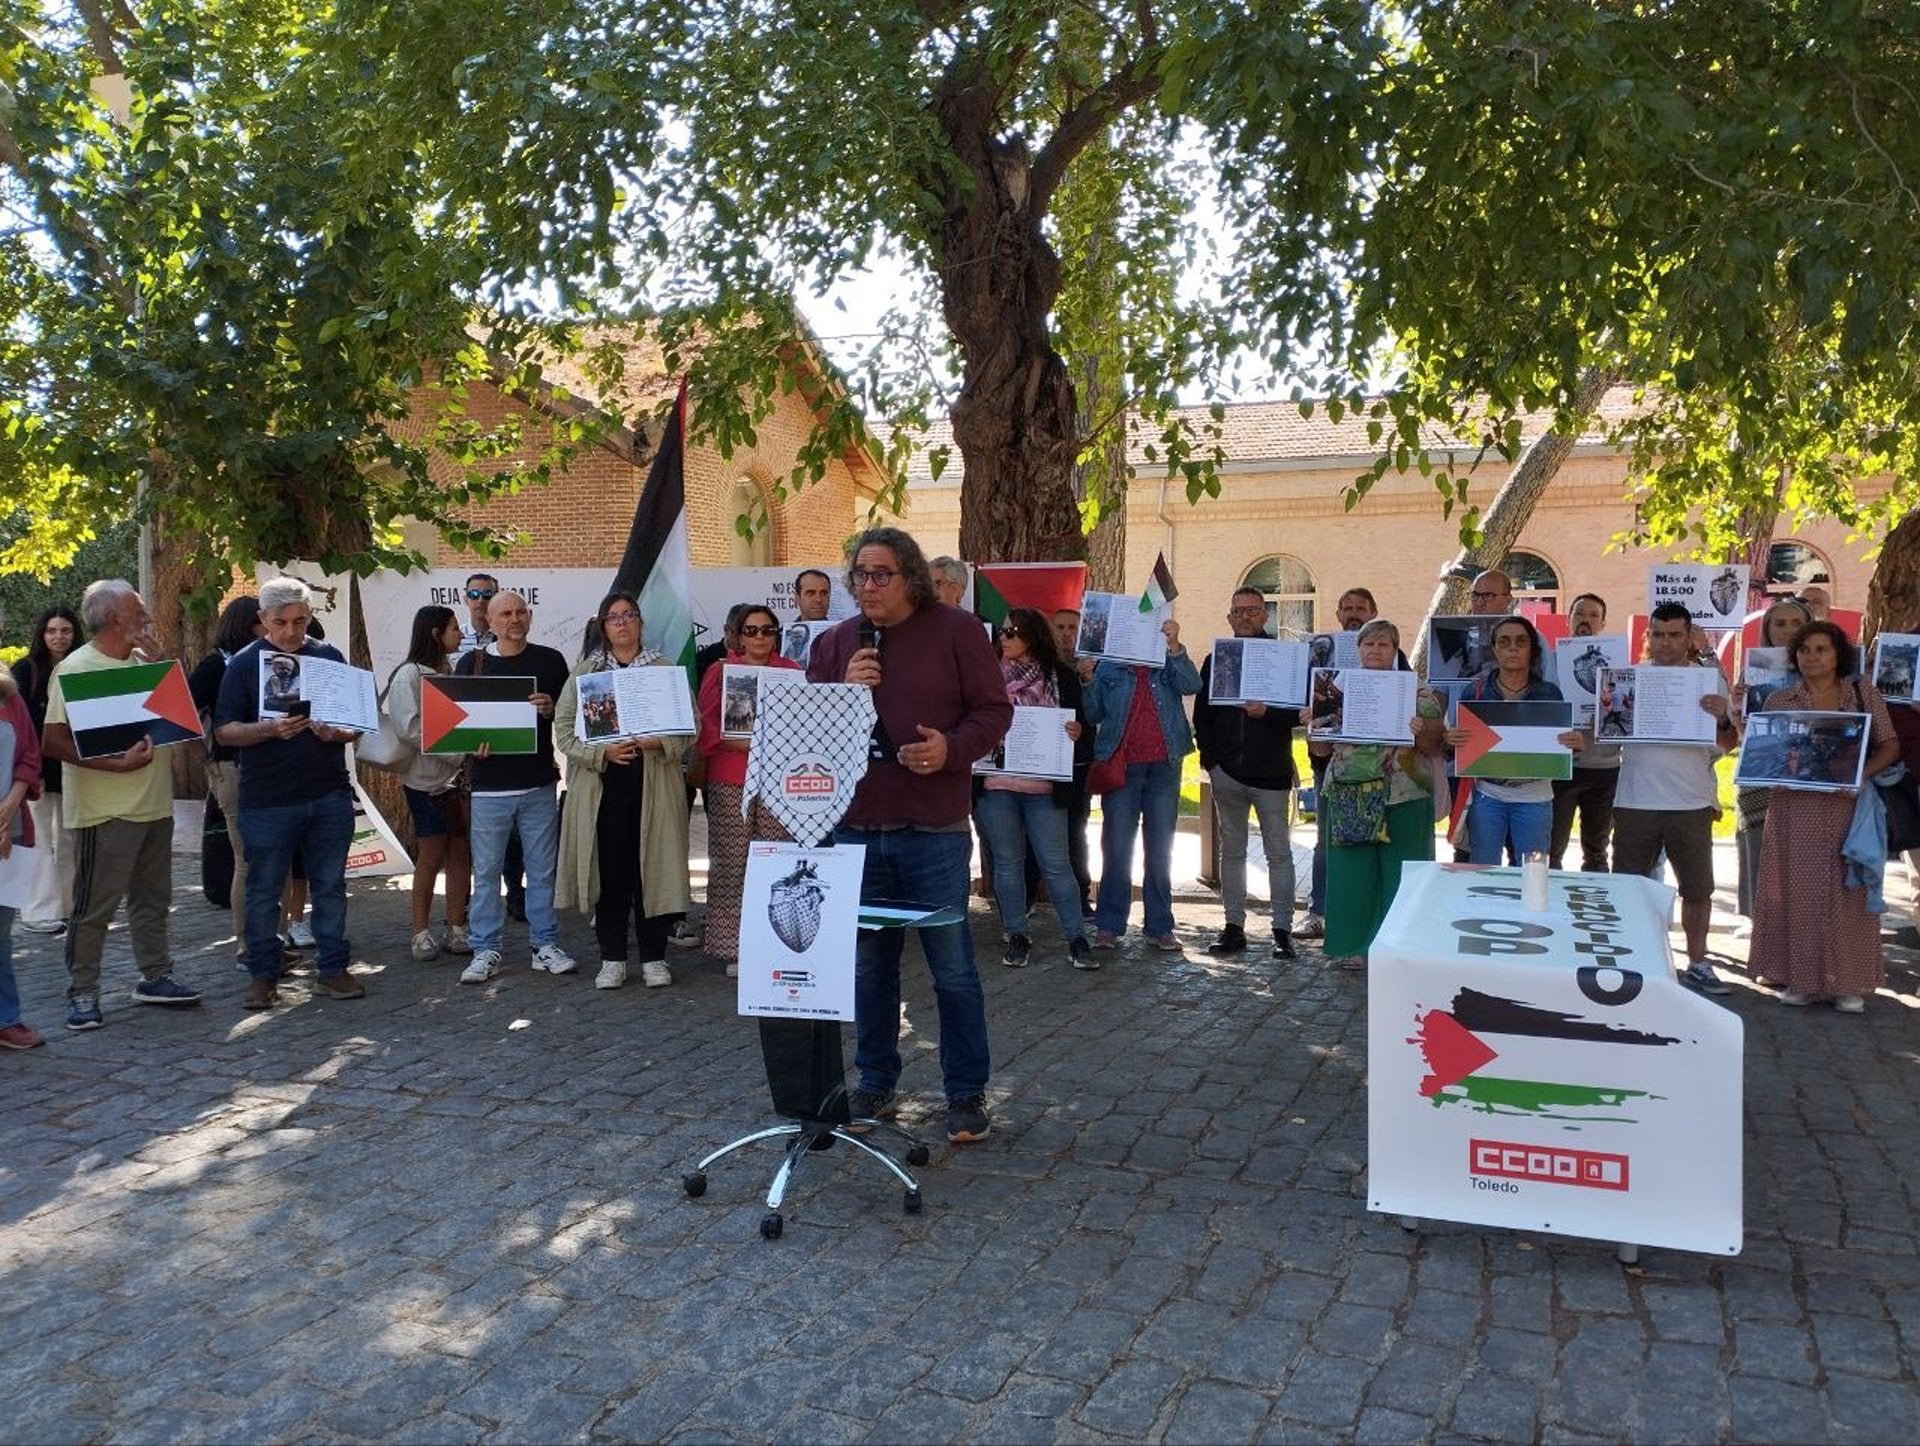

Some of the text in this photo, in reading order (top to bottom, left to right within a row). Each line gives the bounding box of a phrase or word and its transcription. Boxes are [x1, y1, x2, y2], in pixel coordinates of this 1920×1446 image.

[1655, 574, 1697, 583] Más de
[431, 587, 461, 605] DEJA
[1655, 586, 1694, 595] 18.500
[766, 597, 786, 609] ESTE
[789, 779, 832, 790] CCOO
[1476, 1146, 1578, 1179] CCOO
[1469, 1177, 1519, 1194] Toledo
